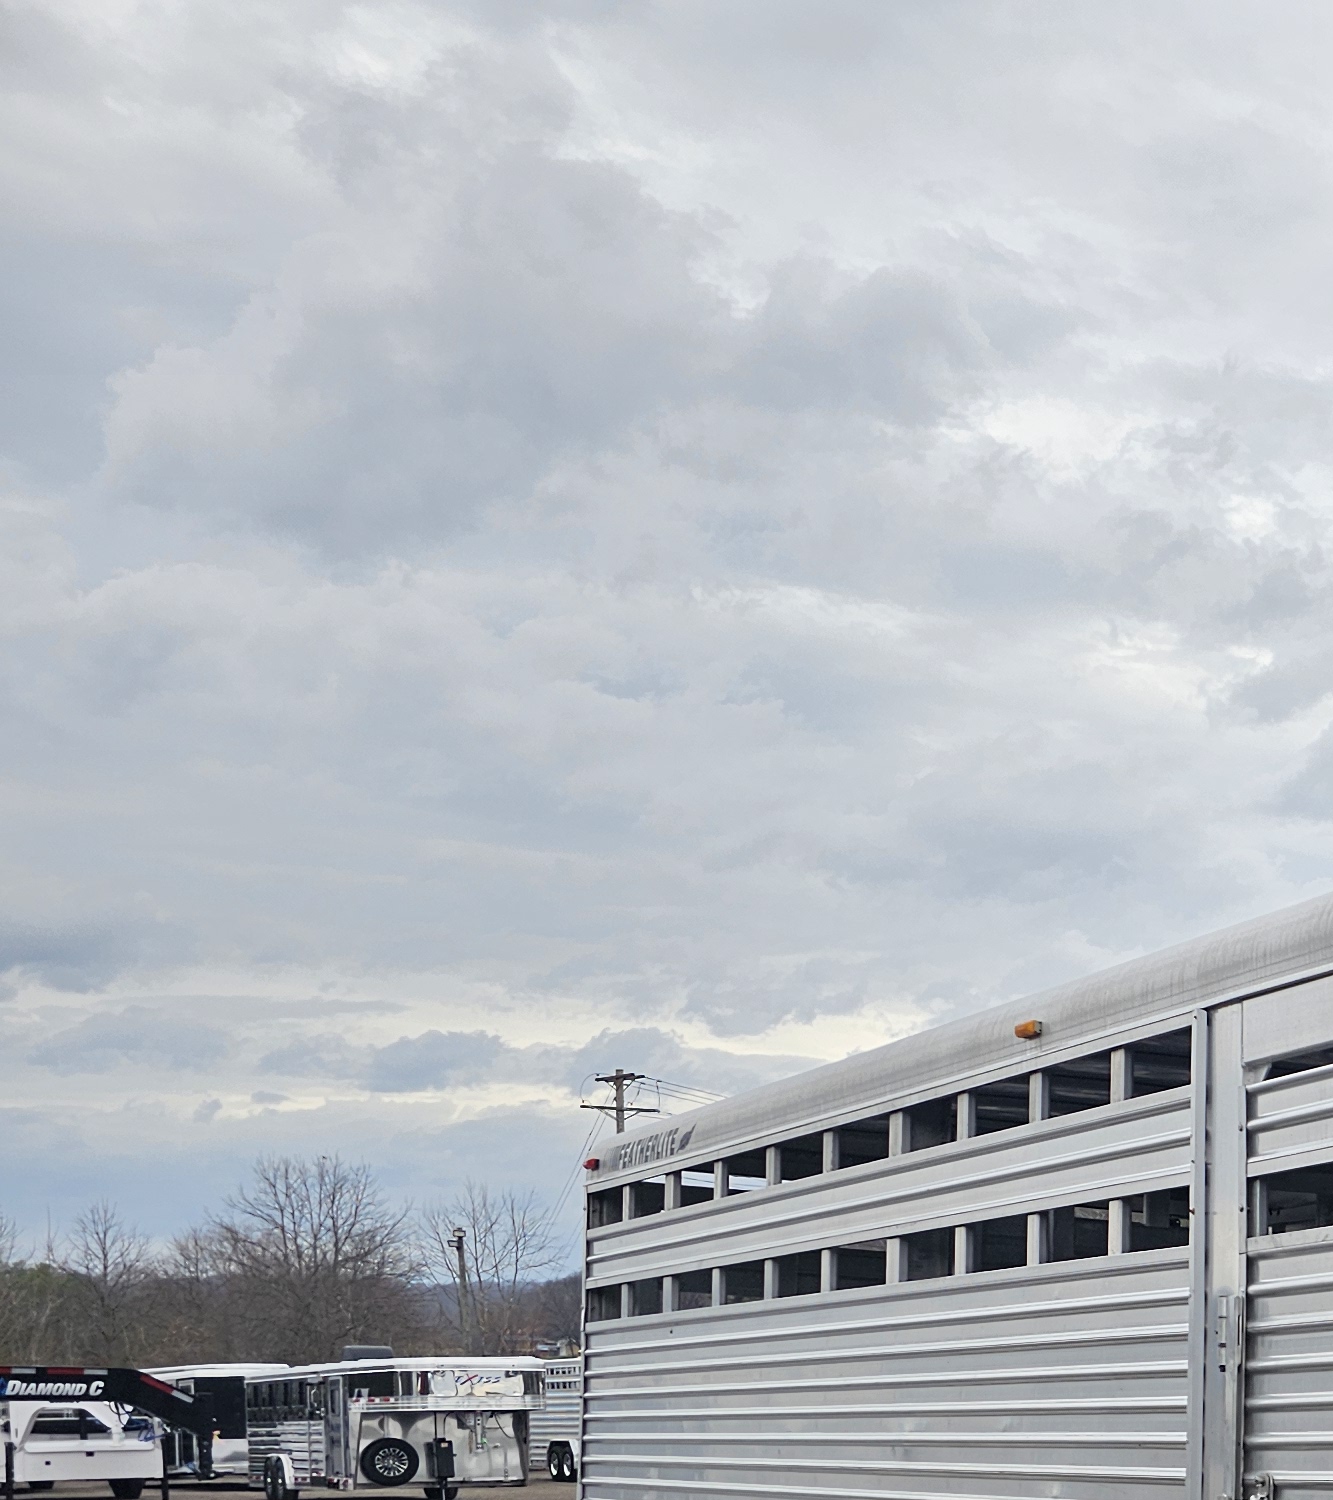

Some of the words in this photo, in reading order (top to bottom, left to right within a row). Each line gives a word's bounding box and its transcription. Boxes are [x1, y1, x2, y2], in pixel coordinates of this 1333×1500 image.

[620, 1128, 679, 1169] FEATHERLITE
[5, 1380, 87, 1396] DIAMOND
[89, 1381, 105, 1396] C
